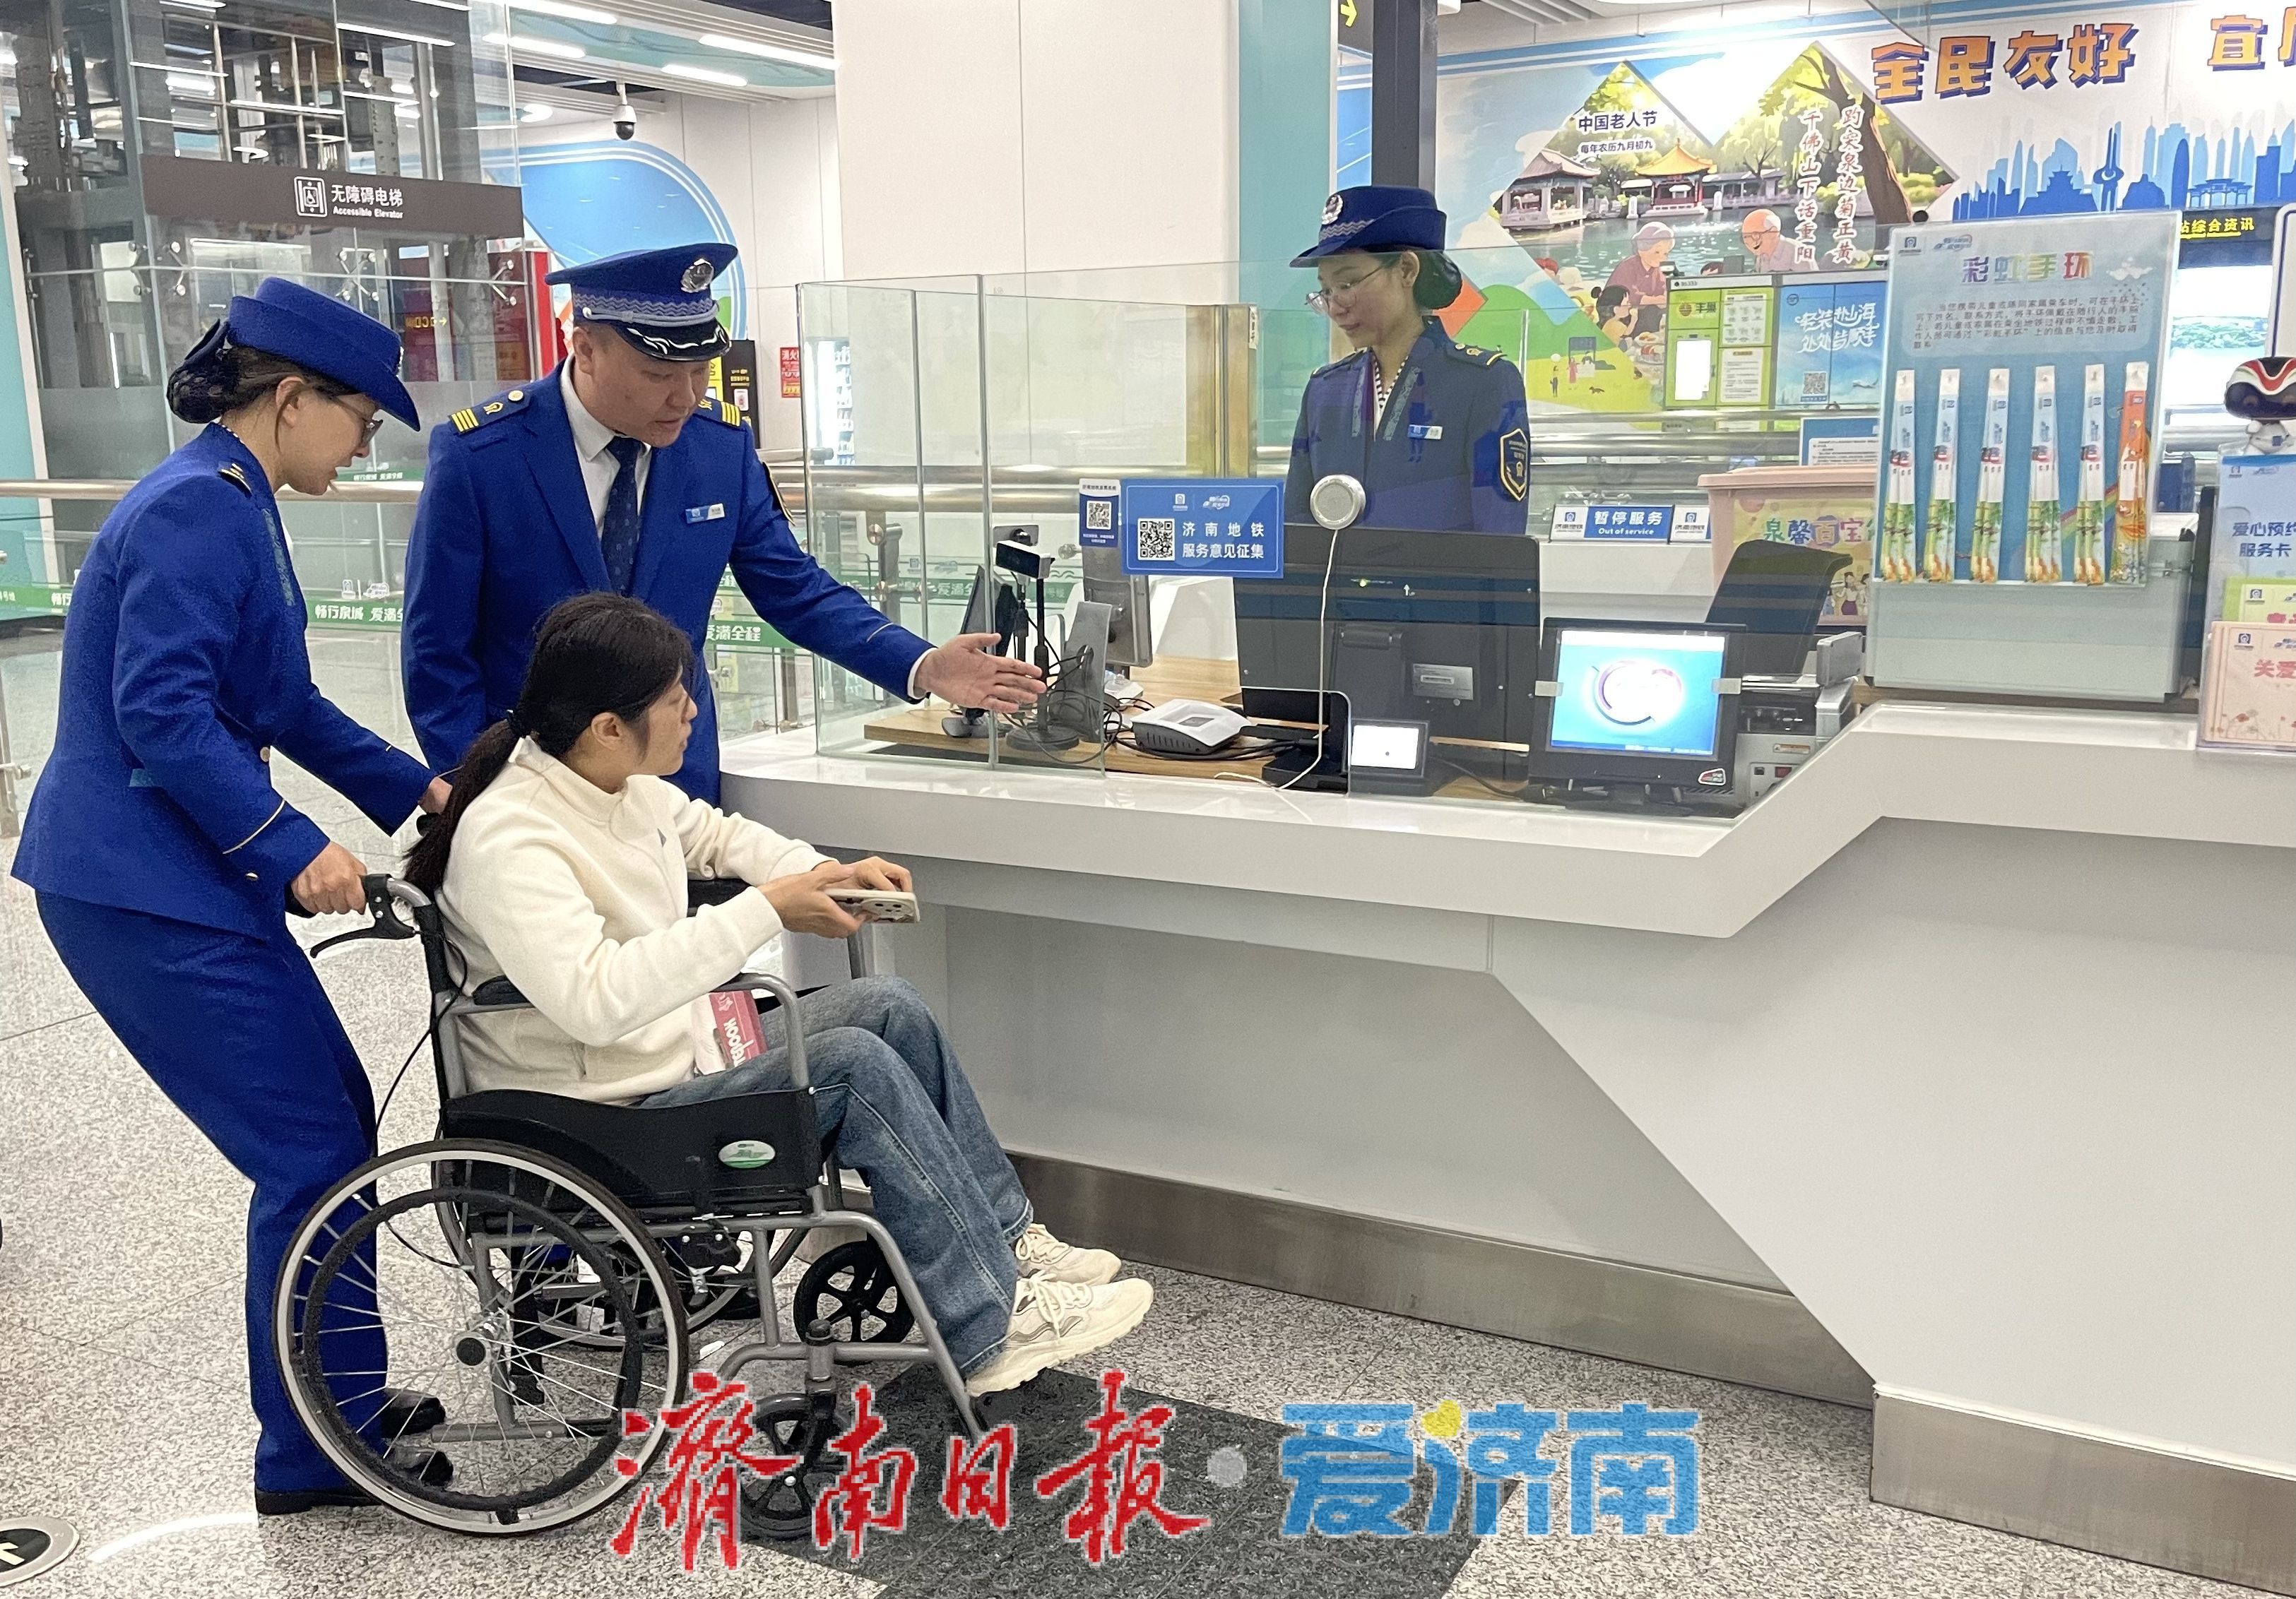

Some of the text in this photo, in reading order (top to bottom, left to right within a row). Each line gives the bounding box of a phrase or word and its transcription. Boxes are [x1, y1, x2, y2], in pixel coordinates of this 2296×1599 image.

[1871, 23, 2138, 105] 全民友好
[1578, 110, 1658, 132] 中国老人节
[1580, 140, 1653, 154] 每年农历九月初九
[1796, 111, 1823, 263] 千佛山下话重阳
[1835, 108, 1864, 263] 趵突泉边菊正黄
[331, 184, 403, 207] 无障碍电梯
[333, 206, 403, 219] Accessible Elevator
[1961, 250, 2093, 283] 彩虹手环
[1594, 511, 1663, 525] 暂停服务
[1182, 522, 1265, 537] 济南地铁
[1182, 543, 1265, 559] 服务意见征集
[2239, 542, 2292, 558] 服务卡
[315, 605, 364, 620] 畅行泉城
